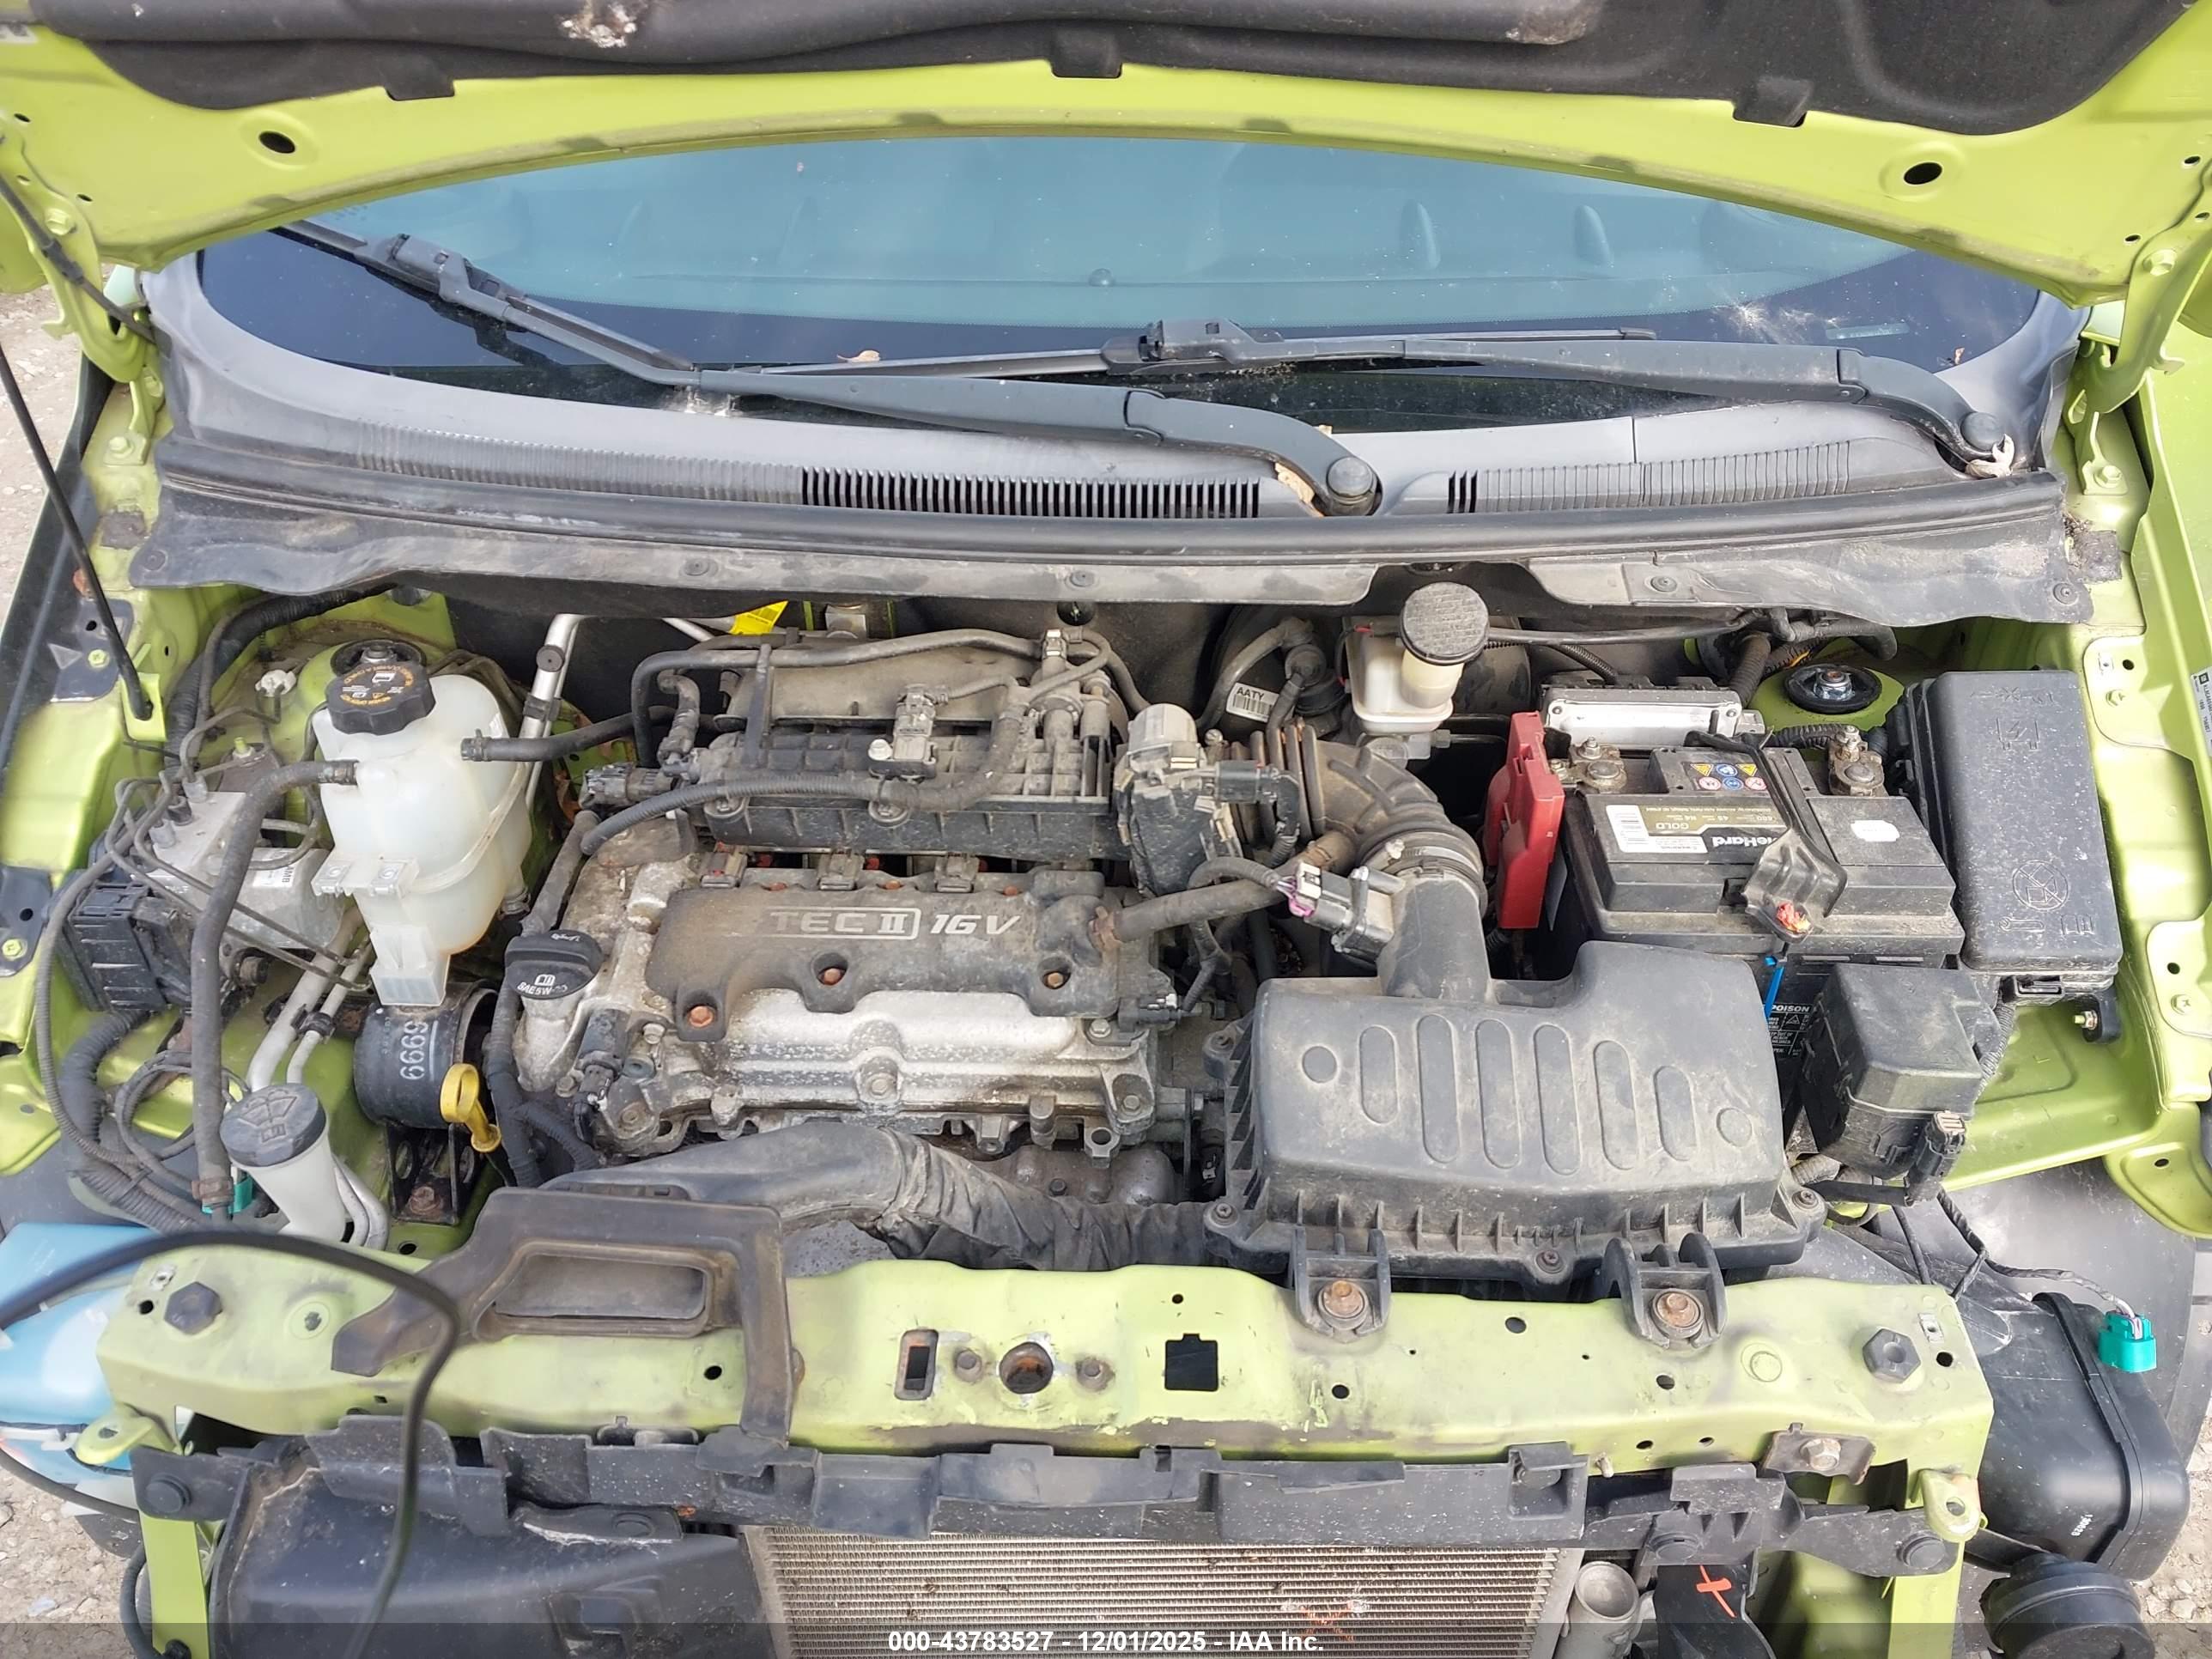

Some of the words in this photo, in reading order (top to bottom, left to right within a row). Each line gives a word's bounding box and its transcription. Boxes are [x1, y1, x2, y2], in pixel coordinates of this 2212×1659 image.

[1237, 687, 1264, 701] AATY
[1711, 836, 1776, 848] ieHard
[770, 912, 866, 933] TEC
[931, 915, 1020, 935] 16V
